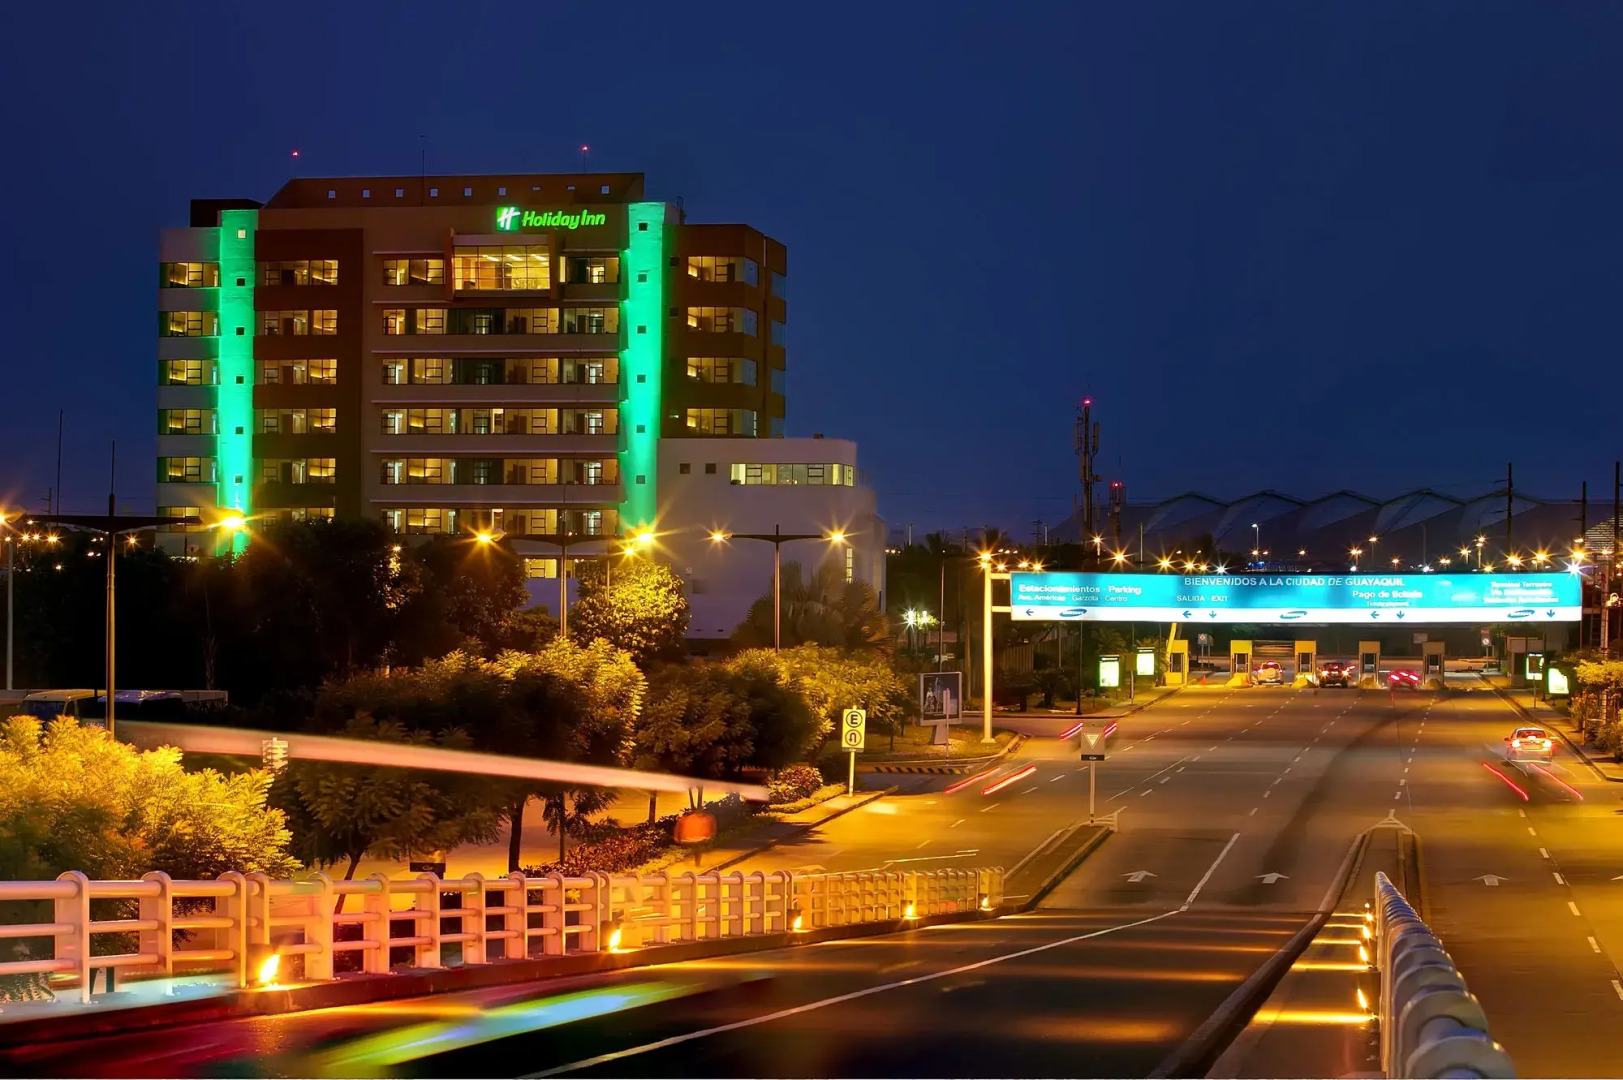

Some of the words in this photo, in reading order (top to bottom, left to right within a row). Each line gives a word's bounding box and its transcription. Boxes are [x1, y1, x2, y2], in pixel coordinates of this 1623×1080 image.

[522, 211, 580, 229] Holiday
[581, 209, 606, 225] Inn
[1184, 577, 1257, 586] BIENVENIDOS
[1259, 577, 1268, 586] A
[1270, 577, 1284, 586] LA
[1286, 577, 1325, 586] CIUDAD
[1328, 577, 1343, 586] DE
[1345, 577, 1406, 586] GUAYAQUIL
[1019, 584, 1101, 593] Estacionamientos
[1108, 585, 1142, 595] Parking
[1352, 590, 1376, 599] Pago
[1378, 590, 1390, 598] de
[850, 714, 858, 725] E
